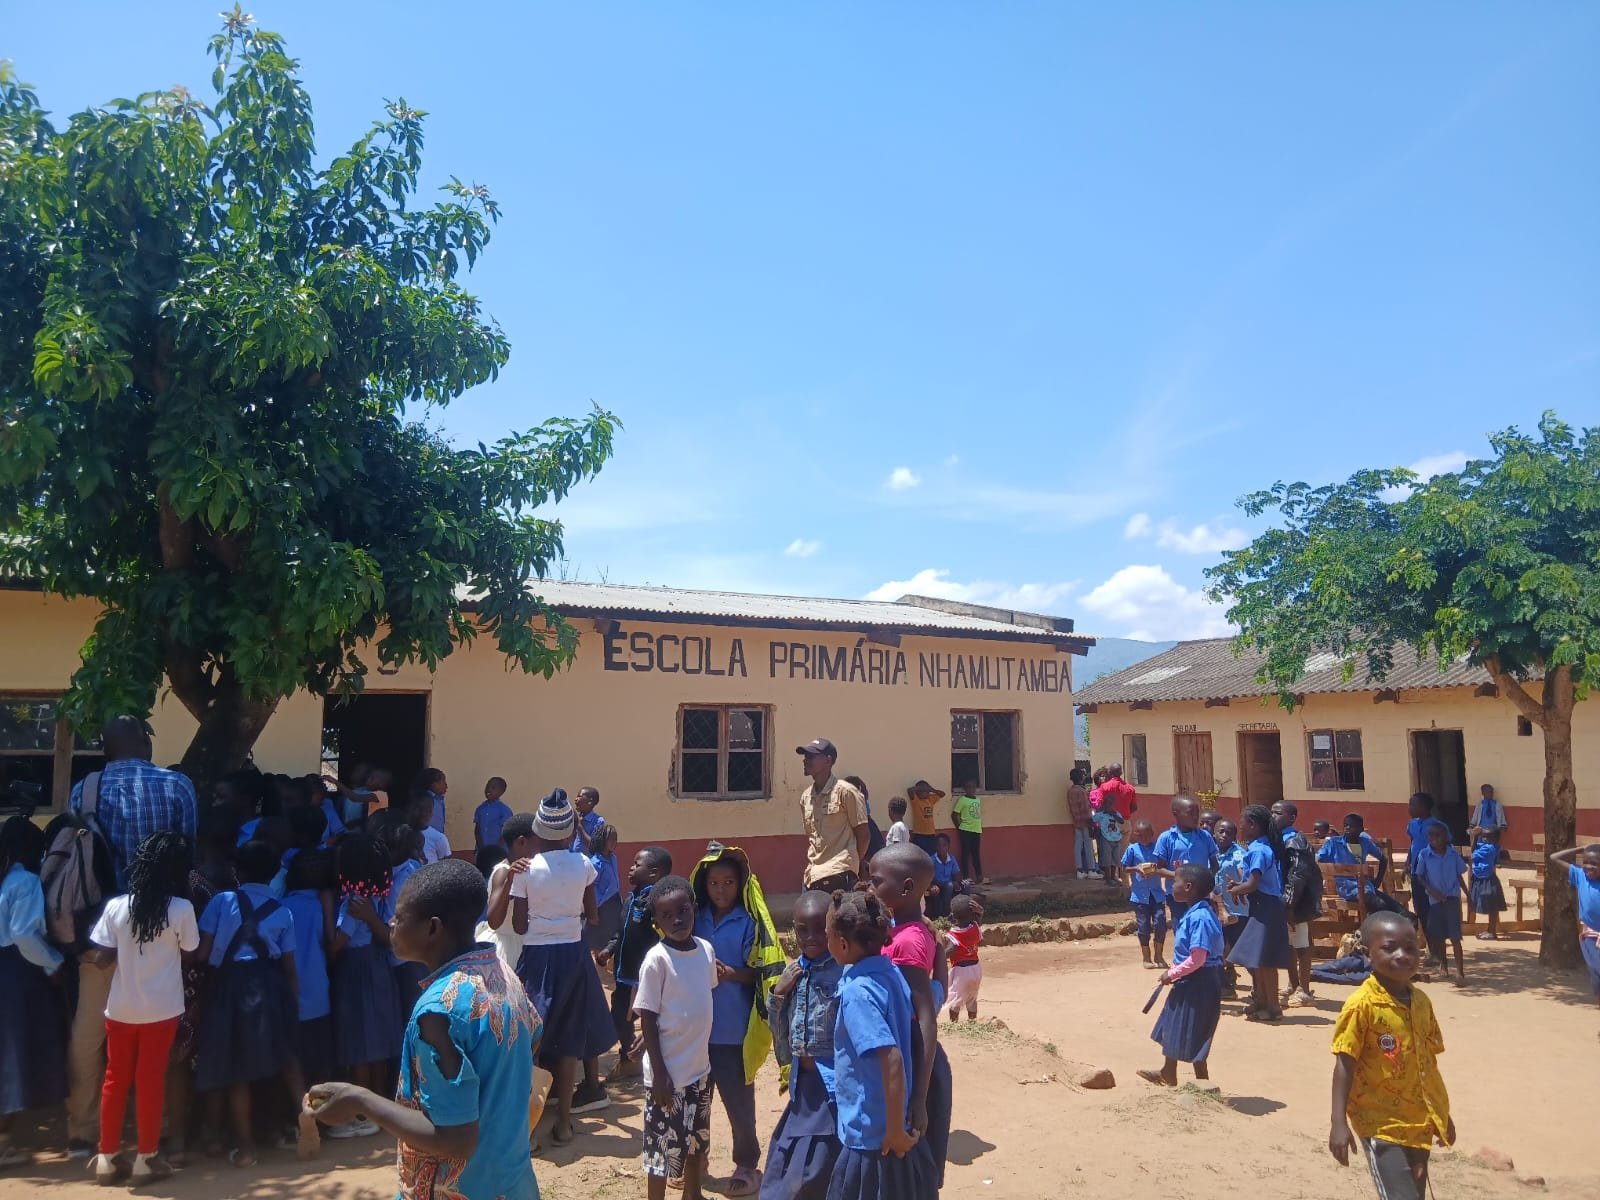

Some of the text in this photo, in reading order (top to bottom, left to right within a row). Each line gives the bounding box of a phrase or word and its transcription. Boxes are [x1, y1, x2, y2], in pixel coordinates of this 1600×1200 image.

[603, 631, 1072, 693] ESCOLA PRIMÁRIA NHAMUTAMBA
